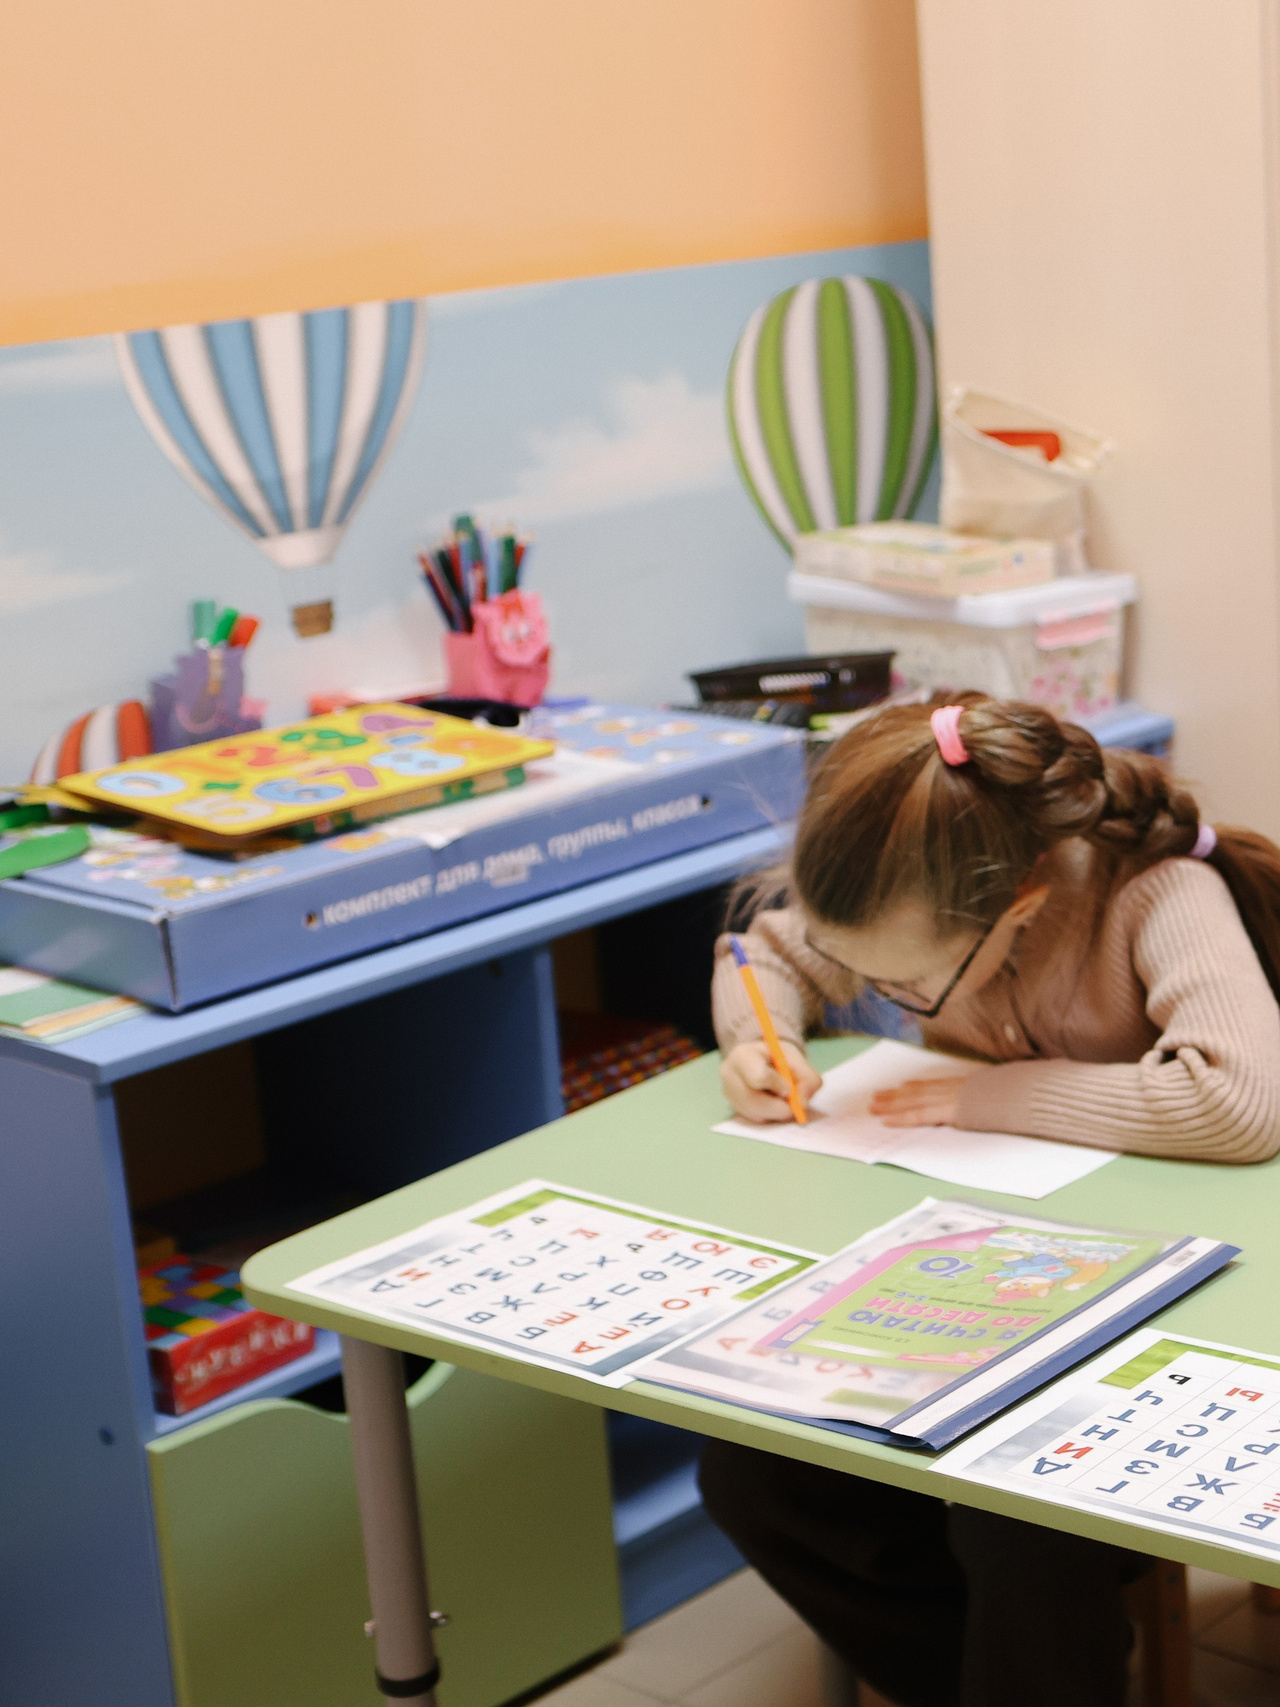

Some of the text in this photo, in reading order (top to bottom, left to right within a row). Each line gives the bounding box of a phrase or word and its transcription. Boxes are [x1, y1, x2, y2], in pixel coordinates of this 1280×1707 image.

[918, 1255, 977, 1279] 10
[863, 1296, 991, 1325] ДЕСЯТИ
[848, 1310, 988, 1340] СЧИТАЮ
[990, 1315, 1044, 1328] ДО
[1133, 1389, 1164, 1406] Ч
[1107, 1408, 1137, 1424] Т
[1199, 1402, 1237, 1422] Ц
[1080, 1424, 1120, 1441] Н
[1175, 1423, 1209, 1438] С
[1052, 1441, 1094, 1460] И
[1144, 1439, 1191, 1459] М
[1243, 1442, 1280, 1456] Р
[1032, 1456, 1073, 1476] Д
[1124, 1459, 1160, 1475] З
[1224, 1456, 1258, 1473] Л
[1095, 1480, 1130, 1494] Г
[1185, 1473, 1238, 1496] Ж
[1166, 1495, 1204, 1513] В
[1239, 1513, 1277, 1531] Б
